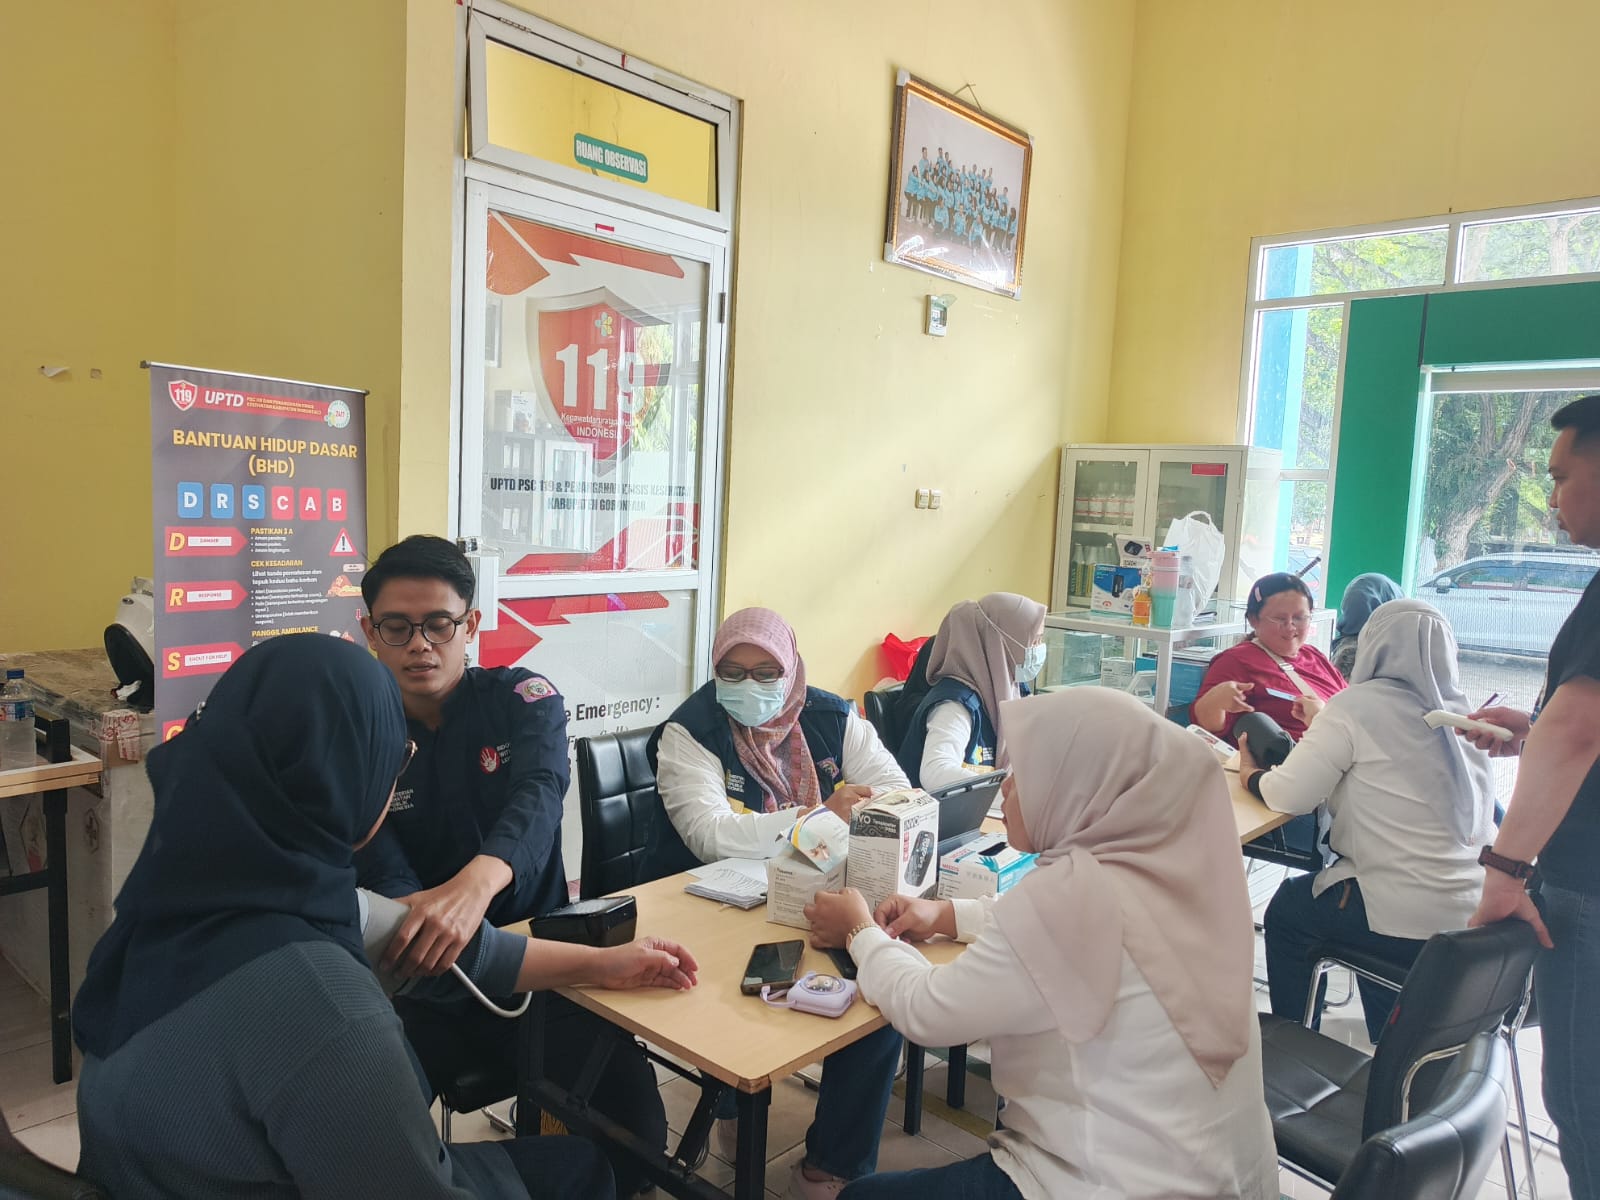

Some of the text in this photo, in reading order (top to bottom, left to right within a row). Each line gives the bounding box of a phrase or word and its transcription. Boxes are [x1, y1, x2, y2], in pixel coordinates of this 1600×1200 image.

[576, 140, 646, 177] RUANG OBSERVASI
[556, 344, 645, 411] 119
[175, 388, 192, 402] 119
[205, 390, 244, 407] UPTD
[576, 426, 621, 438] INDONESI
[173, 429, 358, 458] BANTUAN HIDUP DASAR
[248, 454, 295, 478] (BHD)
[490, 477, 516, 491] UPTD
[518, 479, 537, 492] PSC
[183, 491, 342, 512] D R S C A B
[250, 527, 283, 535] PASTIKAN
[168, 532, 186, 551] D
[250, 559, 303, 568] CEK KESADARAN
[169, 588, 184, 607] R
[167, 652, 181, 672] S
[576, 697, 653, 721] Emergency
